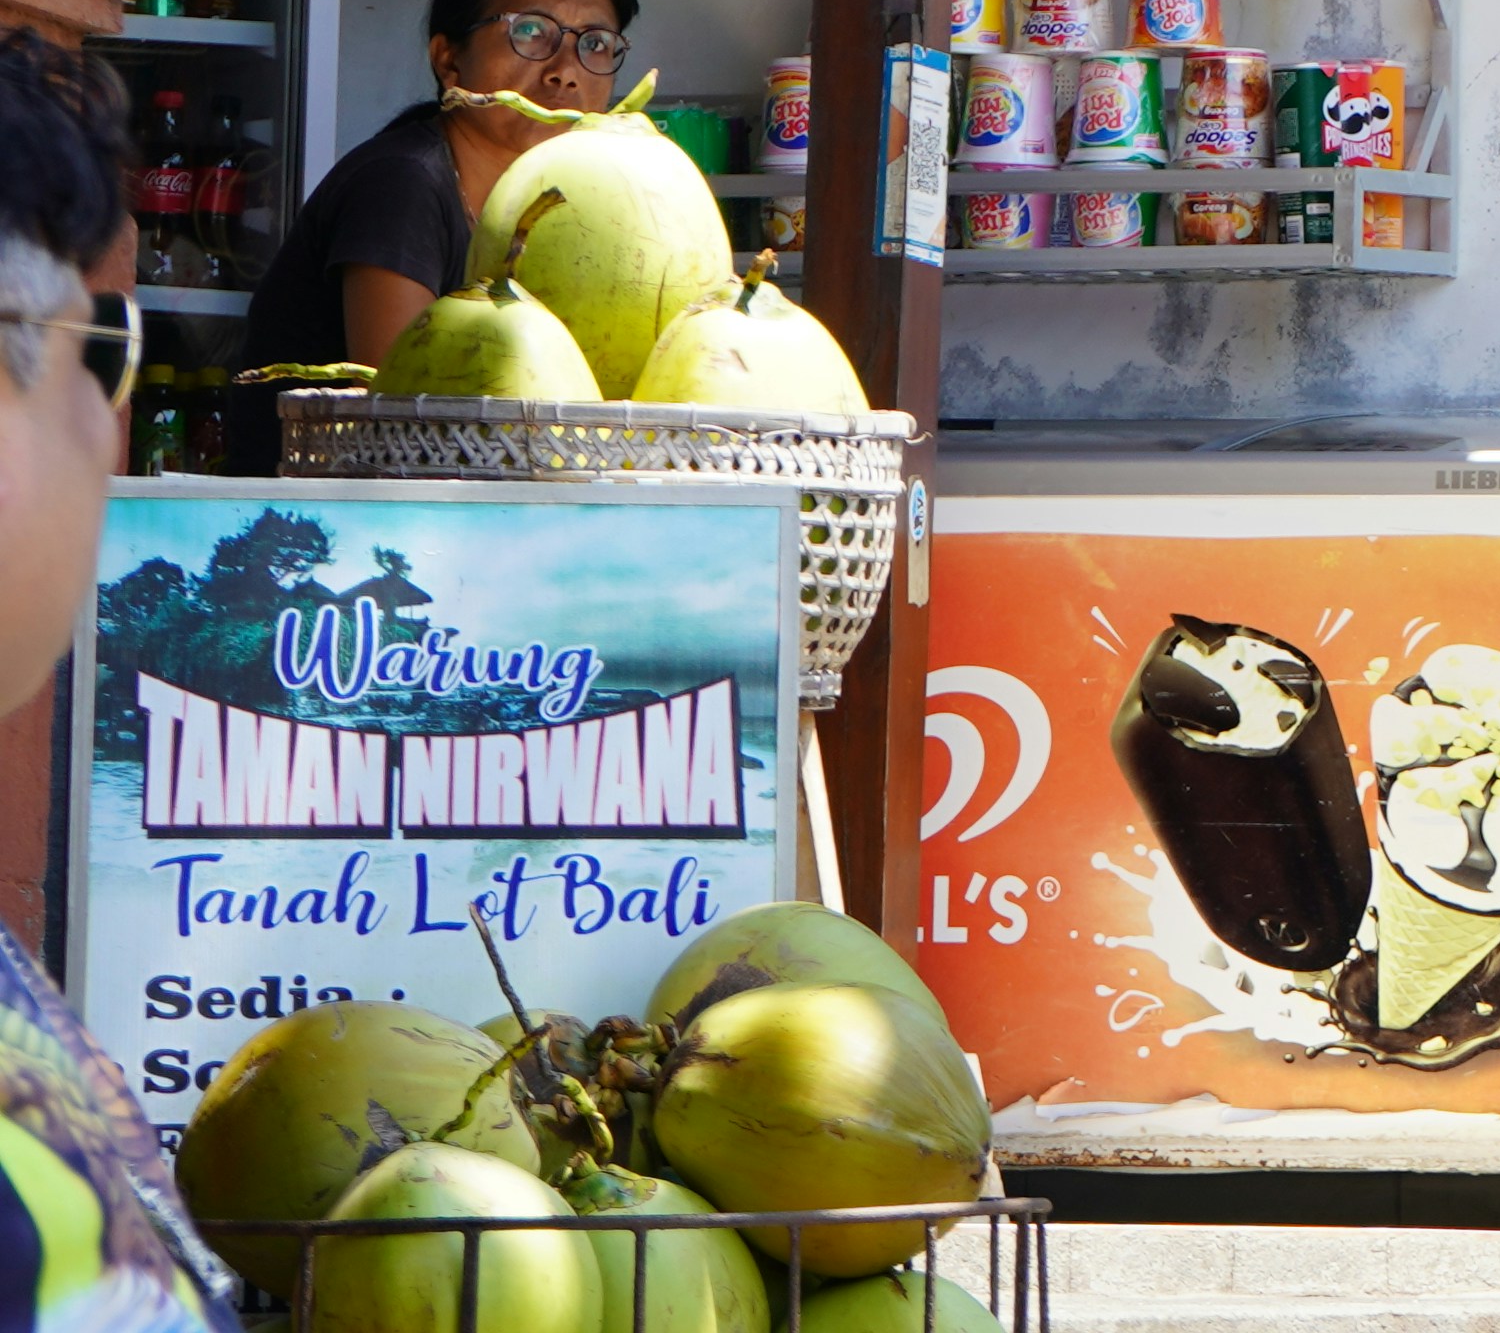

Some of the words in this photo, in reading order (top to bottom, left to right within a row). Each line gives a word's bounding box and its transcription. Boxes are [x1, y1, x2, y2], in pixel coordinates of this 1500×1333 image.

[1020, 21, 1090, 38] Sedaap
[1161, 7, 1198, 30] POP
[970, 111, 1010, 136] POP
[1084, 108, 1124, 134] POP
[967, 192, 1006, 214] POP
[1075, 192, 1112, 216] POP
[1192, 202, 1228, 213] Goreng
[971, 209, 1014, 232] MIE
[1082, 206, 1124, 233] MIE
[277, 599, 600, 720] Warung
[138, 670, 390, 833] TAMAN
[402, 677, 745, 833] NIRWANA
[152, 851, 387, 937] Tanah
[408, 853, 540, 941] Lot
[553, 853, 721, 937] Bali
